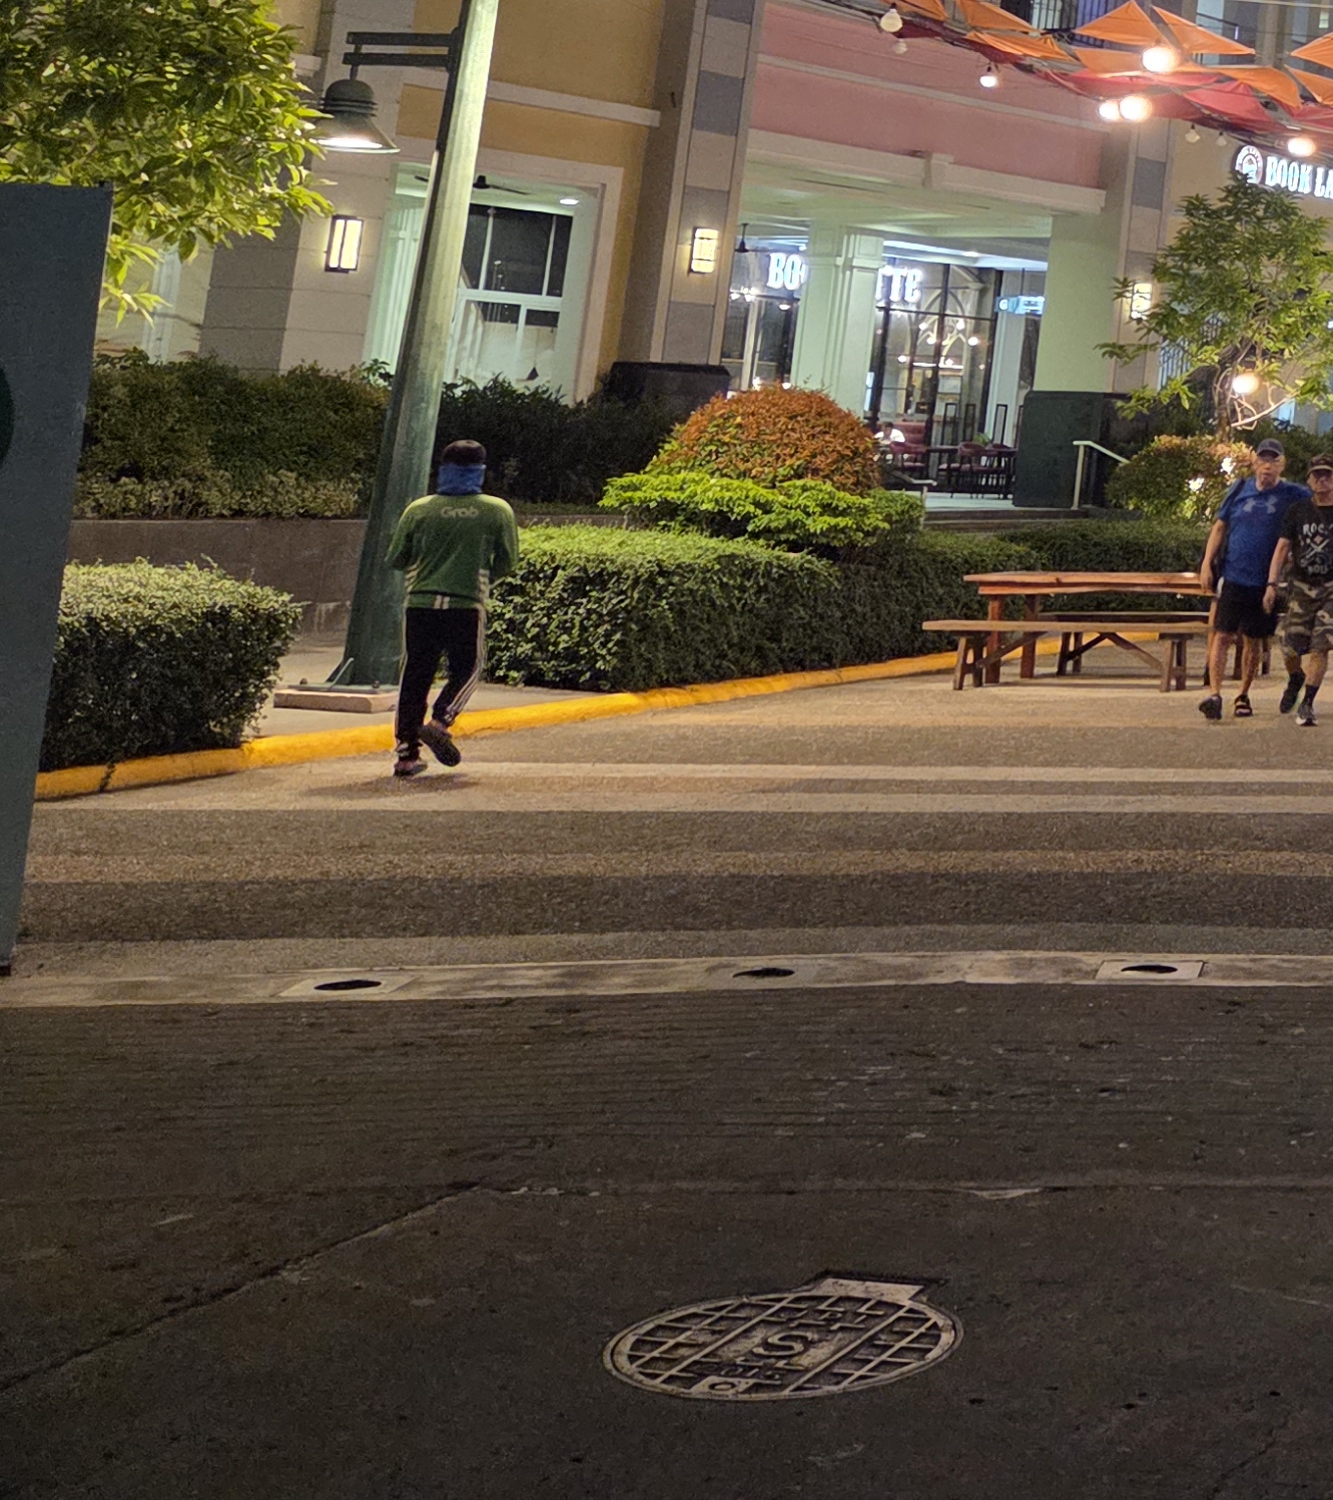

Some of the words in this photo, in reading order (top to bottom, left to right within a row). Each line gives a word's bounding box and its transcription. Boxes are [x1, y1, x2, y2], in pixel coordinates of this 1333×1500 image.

[1265, 155, 1313, 194] BOOK
[441, 506, 479, 519] Grab
[752, 1330, 817, 1357] S
